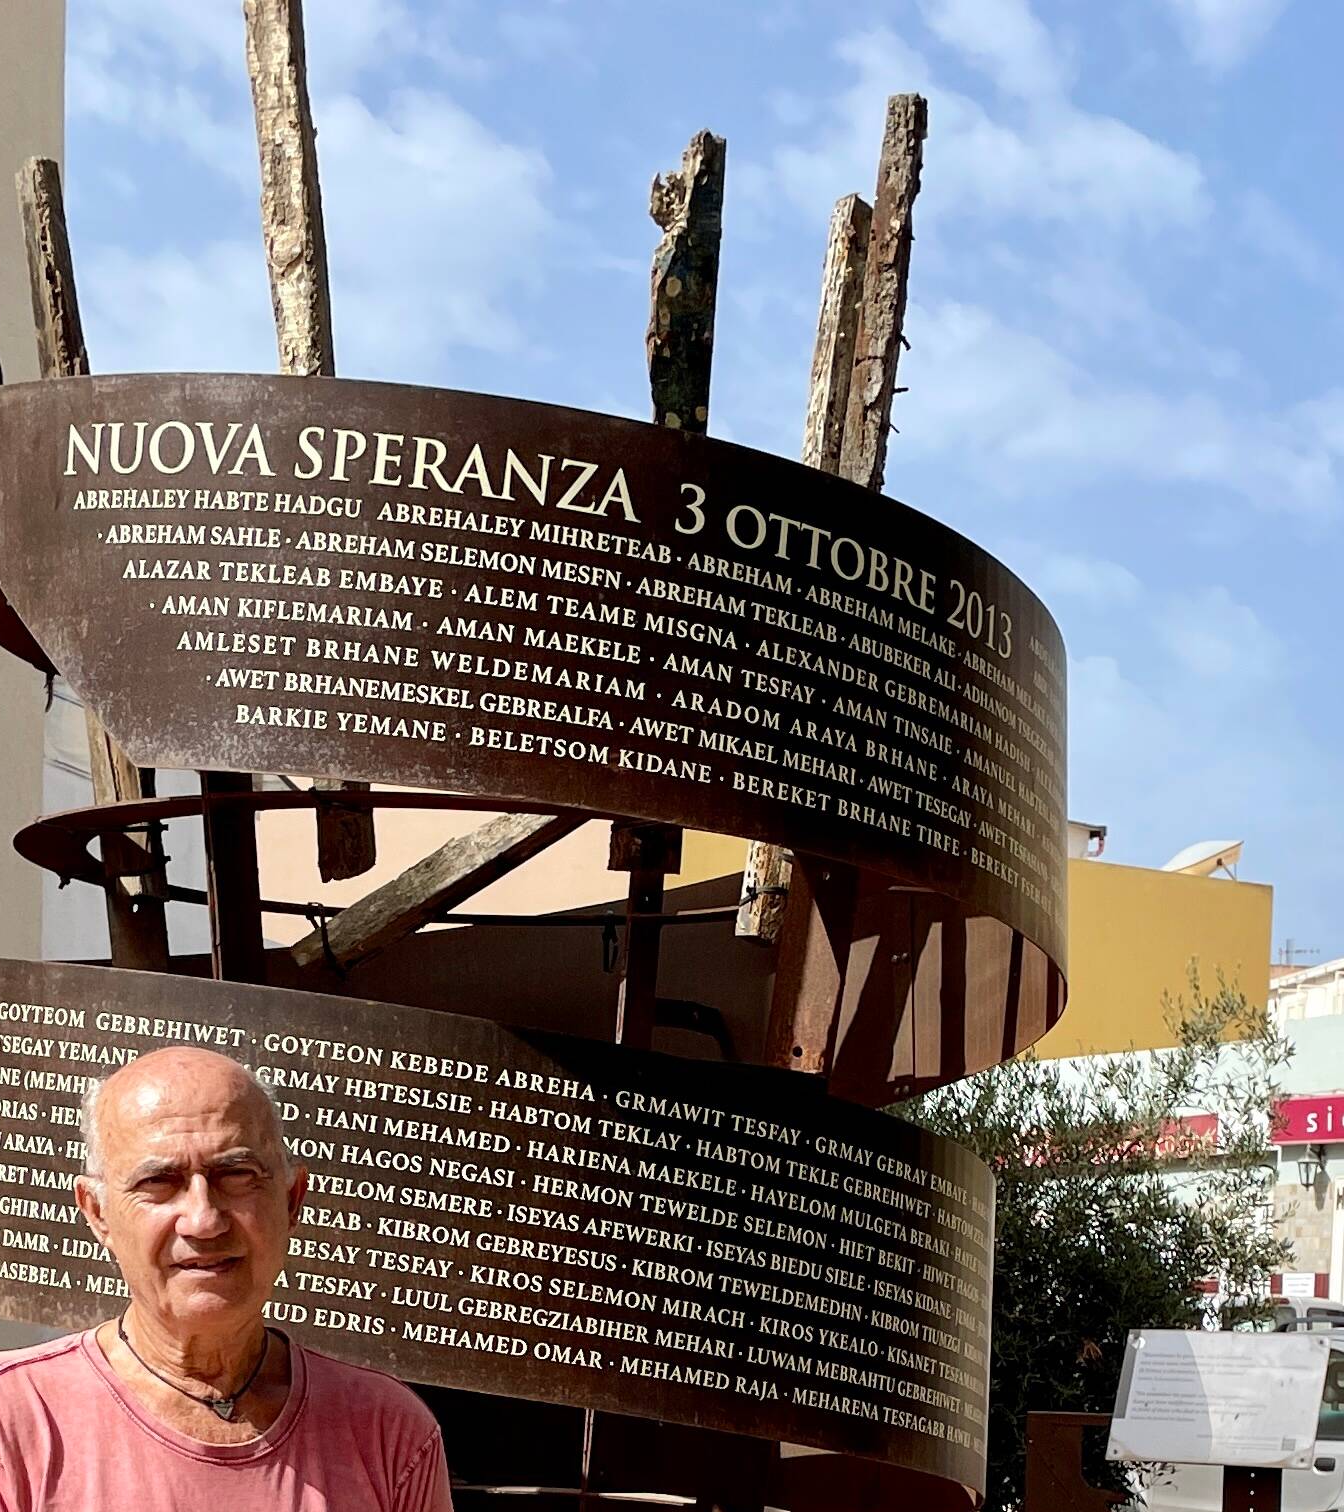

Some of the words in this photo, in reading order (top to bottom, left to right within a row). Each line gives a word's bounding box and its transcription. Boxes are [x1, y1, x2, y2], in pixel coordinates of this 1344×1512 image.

[63, 421, 276, 477] NUOVA
[294, 427, 641, 523] SPERANZA
[675, 484, 705, 534] 3
[726, 505, 936, 614] OTTOBRE
[947, 580, 1011, 658] 2013
[74, 487, 190, 511] ABREHALEY
[194, 490, 269, 511] HABTE
[274, 494, 362, 518] HADGU
[377, 503, 525, 537] ABREHALEY
[529, 521, 671, 563] MIHRETEAB
[688, 553, 792, 595] ABREHAM
[105, 524, 206, 544] ABREHAM
[210, 526, 280, 547] SAHLE
[295, 531, 415, 559] ABREHAM
[421, 543, 536, 575] SELEMON
[541, 559, 622, 590] MESFN
[636, 577, 746, 617] ABREHAM
[751, 602, 836, 642] TEKLEAB
[123, 560, 211, 580] ALAZAR
[219, 562, 330, 586] TEKLEAB
[339, 570, 442, 598] EMBAYE
[464, 584, 538, 611] ALEM
[547, 595, 636, 628] TEAME
[644, 613, 737, 650] MISGNA
[756, 640, 878, 692] ALEXANDER
[162, 595, 230, 617] AMAN
[237, 598, 413, 631] KIFLEMARIAM
[437, 617, 515, 643] AMAN
[524, 628, 640, 664] MAEKELE
[663, 653, 733, 683] AMAN
[741, 670, 815, 704] TESFAY
[177, 631, 296, 655] AMLESET
[306, 638, 418, 666] BRHANE
[431, 650, 645, 700] WELDEMARIAM
[671, 690, 780, 730] ARADOM
[789, 719, 857, 752] ARAYA
[215, 669, 280, 690] AWET
[284, 672, 474, 709] BRHANEMESKEL
[480, 693, 613, 730] GEBREALFA
[629, 717, 694, 744] AWET
[698, 730, 778, 764] MIKAEL
[782, 749, 855, 785] MEHARI
[236, 705, 327, 729] BARKIE
[337, 712, 446, 741] YEMANE
[469, 727, 609, 764] BELETSOM
[618, 749, 711, 783] KIDANE
[733, 772, 831, 811] BEREKET
[838, 799, 911, 836] BRHANE
[96, 1013, 245, 1046] GEBREHIWET
[264, 1034, 383, 1066] GOYTEON
[390, 1051, 488, 1083] KEBEDE
[495, 1069, 595, 1101] ABREHA
[616, 1091, 725, 1127] GRMAWIT
[731, 1115, 801, 1145] TESFAY
[344, 1078, 472, 1113] HBTESLSIE
[489, 1101, 591, 1134] HABTOM
[598, 1120, 681, 1151] TEKLAY
[696, 1139, 780, 1174] HABTOM
[3, 1133, 55, 1156] ARAYA
[400, 1188, 492, 1217] SEMERE
[507, 1204, 579, 1231] ISEYAS
[583, 1218, 694, 1252] AFEWERKI
[706, 1240, 766, 1267] ISEYAS
[316, 1108, 378, 1133] HANI
[383, 1118, 510, 1152] MEHAMED
[529, 1141, 631, 1175] HARIENA
[637, 1161, 736, 1196] MAEKELE
[341, 1145, 422, 1173] HAGOS
[429, 1158, 515, 1188] NEGASI
[533, 1174, 633, 1209] HERMON
[639, 1194, 738, 1229] TEWELDE
[744, 1216, 827, 1249] SELEMON
[0, 1197, 81, 1224] GHIRMAY
[366, 1249, 453, 1278] TESFAY
[470, 1265, 542, 1292] KIROS
[549, 1278, 657, 1311] SELEMON
[662, 1298, 745, 1328] MIRACH
[759, 1316, 814, 1342] KIROS
[2, 1229, 50, 1253] DAMR
[62, 1238, 111, 1262] LIDIA
[295, 1272, 377, 1300] TESFAY
[391, 1287, 452, 1312] LUUL
[458, 1298, 649, 1344] GEBREGZIABIHER
[654, 1329, 734, 1358] MEHARI
[377, 1217, 470, 1248] KIBROM
[476, 1233, 617, 1271] GEBREYESUS
[632, 1259, 713, 1289] KIBROM
[313, 1308, 384, 1334] EDRIS
[402, 1321, 527, 1355] MEHAMED
[534, 1343, 602, 1369] OMAR
[620, 1356, 729, 1389] MEHAMED
[735, 1376, 778, 1400] RAJA
